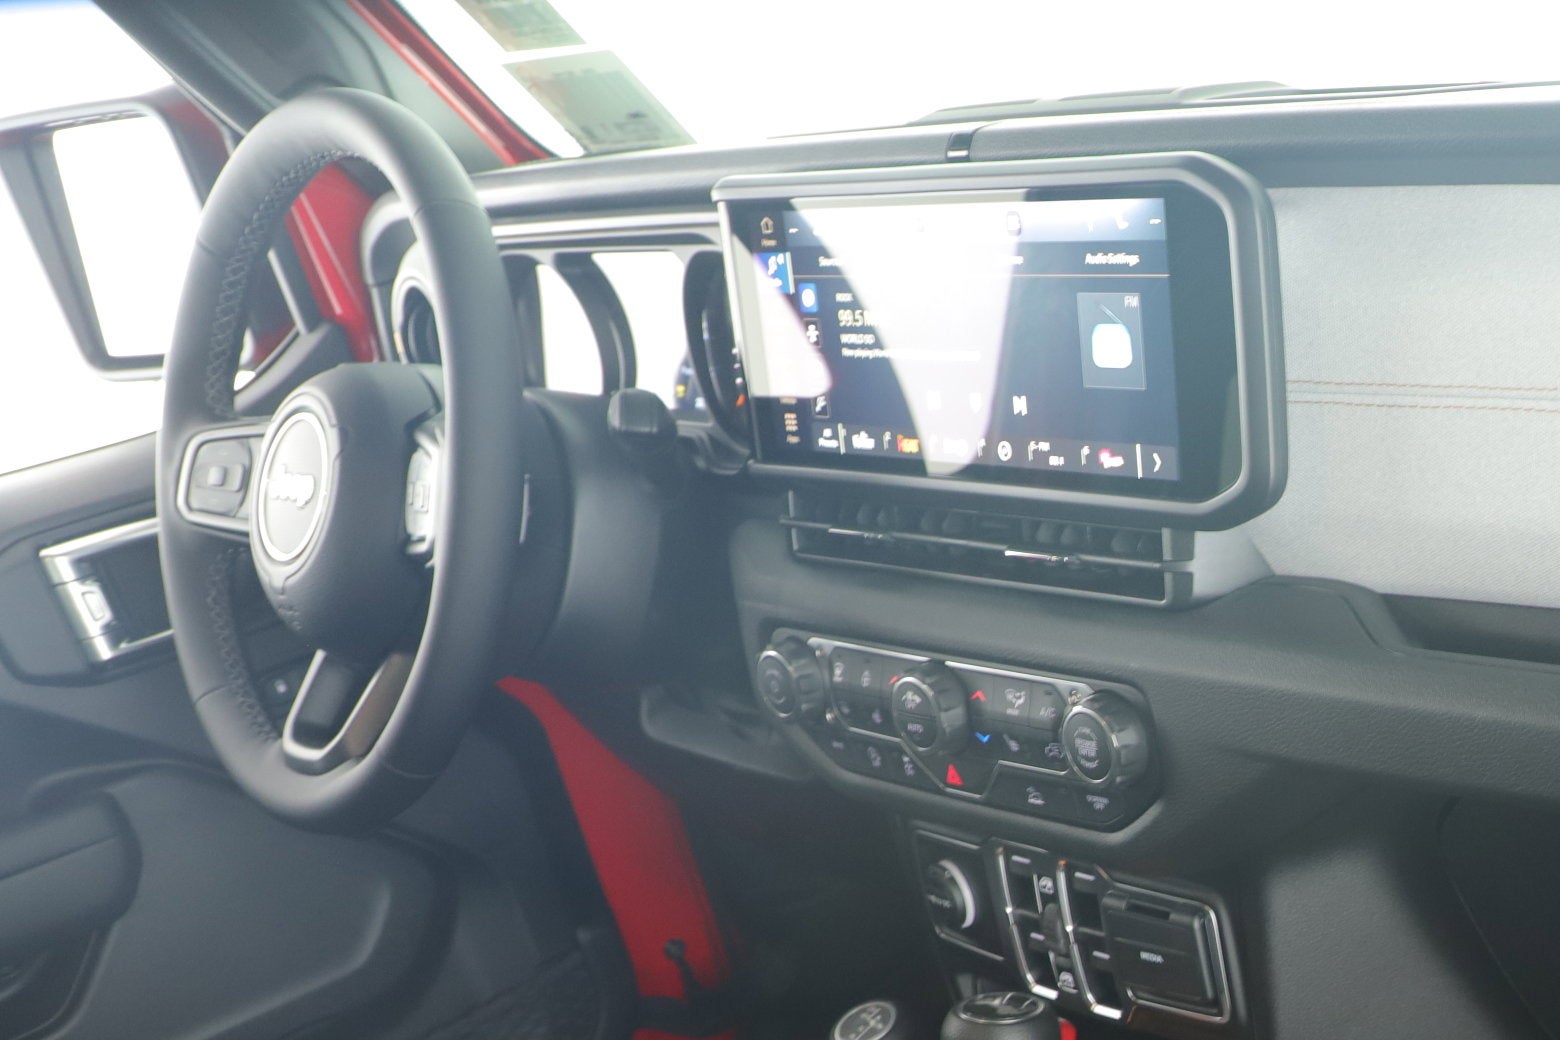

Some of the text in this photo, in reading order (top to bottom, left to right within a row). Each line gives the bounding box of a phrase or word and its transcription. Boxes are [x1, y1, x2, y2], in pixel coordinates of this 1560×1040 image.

[1085, 253, 1140, 267] Audio Settings
[1124, 296, 1139, 308] FM
[838, 309, 864, 328] 99.5
[1140, 951, 1164, 964] MEDIA
